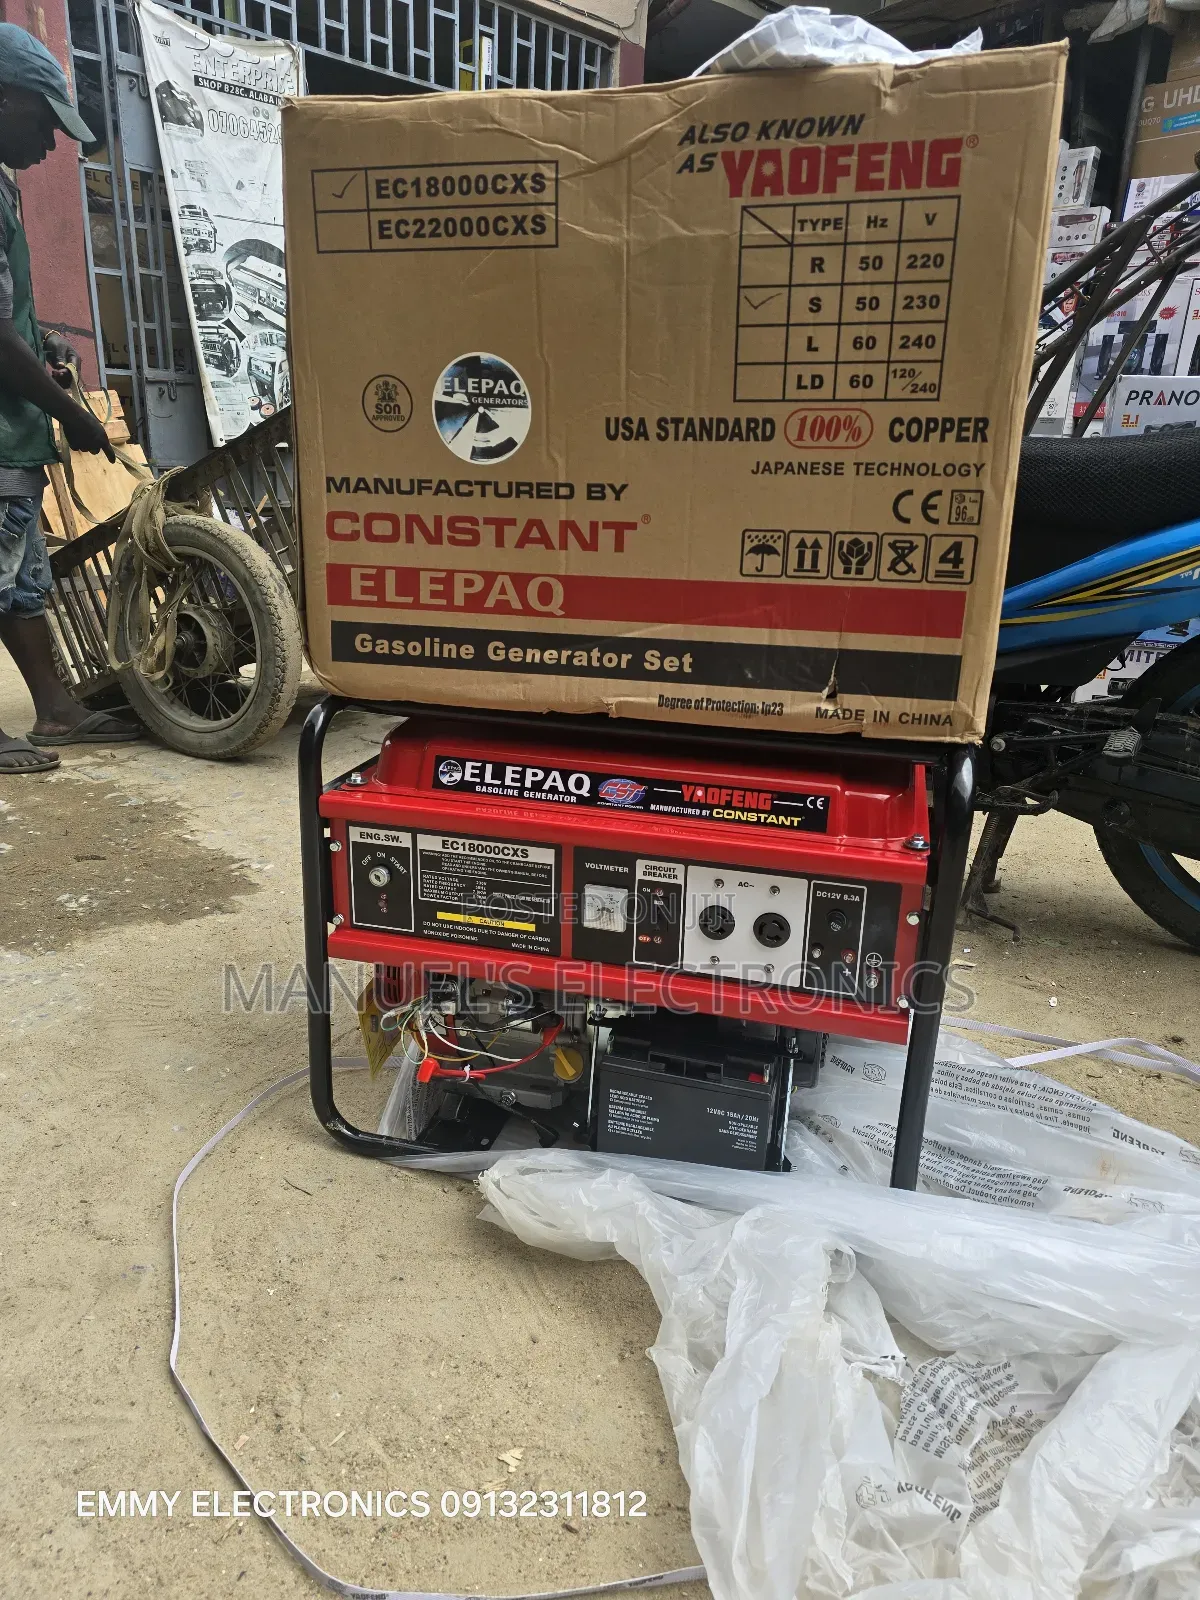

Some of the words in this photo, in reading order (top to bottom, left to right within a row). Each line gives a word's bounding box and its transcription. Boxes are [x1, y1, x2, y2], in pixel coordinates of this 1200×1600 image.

[198, 77, 222, 91] SHOP
[249, 90, 275, 104] ALABA
[1141, 96, 1155, 113] G
[677, 122, 749, 146] ALSO
[755, 113, 867, 141] KNOWN
[676, 152, 716, 175] AS
[721, 136, 966, 198] YAOFENG
[375, 172, 547, 201] EC18000CXS
[377, 213, 547, 241] EC22000CXS
[797, 216, 844, 233] TYPE
[866, 215, 889, 230] Hz
[924, 213, 937, 227] V
[809, 257, 826, 274] R
[858, 255, 884, 271] 50
[905, 252, 945, 269] 220
[808, 297, 823, 314] S
[855, 296, 880, 312] 50
[902, 294, 941, 310] 230
[806, 336, 819, 353] L
[852, 335, 878, 352] 60
[899, 334, 937, 351] 240
[441, 377, 527, 396] ELEPAQ
[795, 374, 825, 391] LD
[848, 373, 874, 390] 60
[471, 396, 530, 407] GENERATORS
[371, 413, 406, 423] APPROVED
[605, 417, 649, 442] USA
[656, 417, 776, 442] STANDARD
[793, 413, 862, 443] 100%
[888, 416, 989, 443] COPPER
[751, 460, 845, 476] JAPANESE
[853, 461, 986, 478] TECHNOLOGY
[325, 476, 575, 500] MANUFACTURED
[586, 483, 629, 501] BY
[892, 489, 943, 524] CE
[955, 505, 967, 521] 96
[326, 510, 638, 553] CONSTANT
[938, 541, 964, 569] 4
[350, 567, 566, 616] ELEPAQ
[354, 633, 475, 660] Gasoline
[487, 641, 632, 669] Generator
[644, 650, 693, 673] Set
[657, 694, 691, 711] Degree
[692, 696, 703, 710] of
[704, 697, 759, 715] Protection:
[815, 706, 866, 723] MADE
[873, 709, 890, 723] IN
[898, 711, 954, 727] CHINA
[464, 761, 591, 796] ELEPAQ
[475, 785, 519, 797] GASOLINE
[523, 791, 577, 803] GENERATOR
[681, 784, 773, 810] YAOFENG
[807, 796, 825, 810] CE
[650, 803, 700, 815] MANUFACTURED
[701, 809, 710, 817] BY
[712, 808, 802, 827] CONSTANT
[359, 831, 403, 844] ENG.SW.
[441, 839, 529, 859] EC18000CXS
[361, 854, 372, 866] OFF
[390, 856, 408, 875] START
[585, 862, 629, 873] VOLTMETER
[644, 864, 677, 873] CIRCUIT
[642, 871, 678, 880] BREAKER
[816, 890, 841, 901] DC12V
[843, 894, 861, 903] 8.3A
